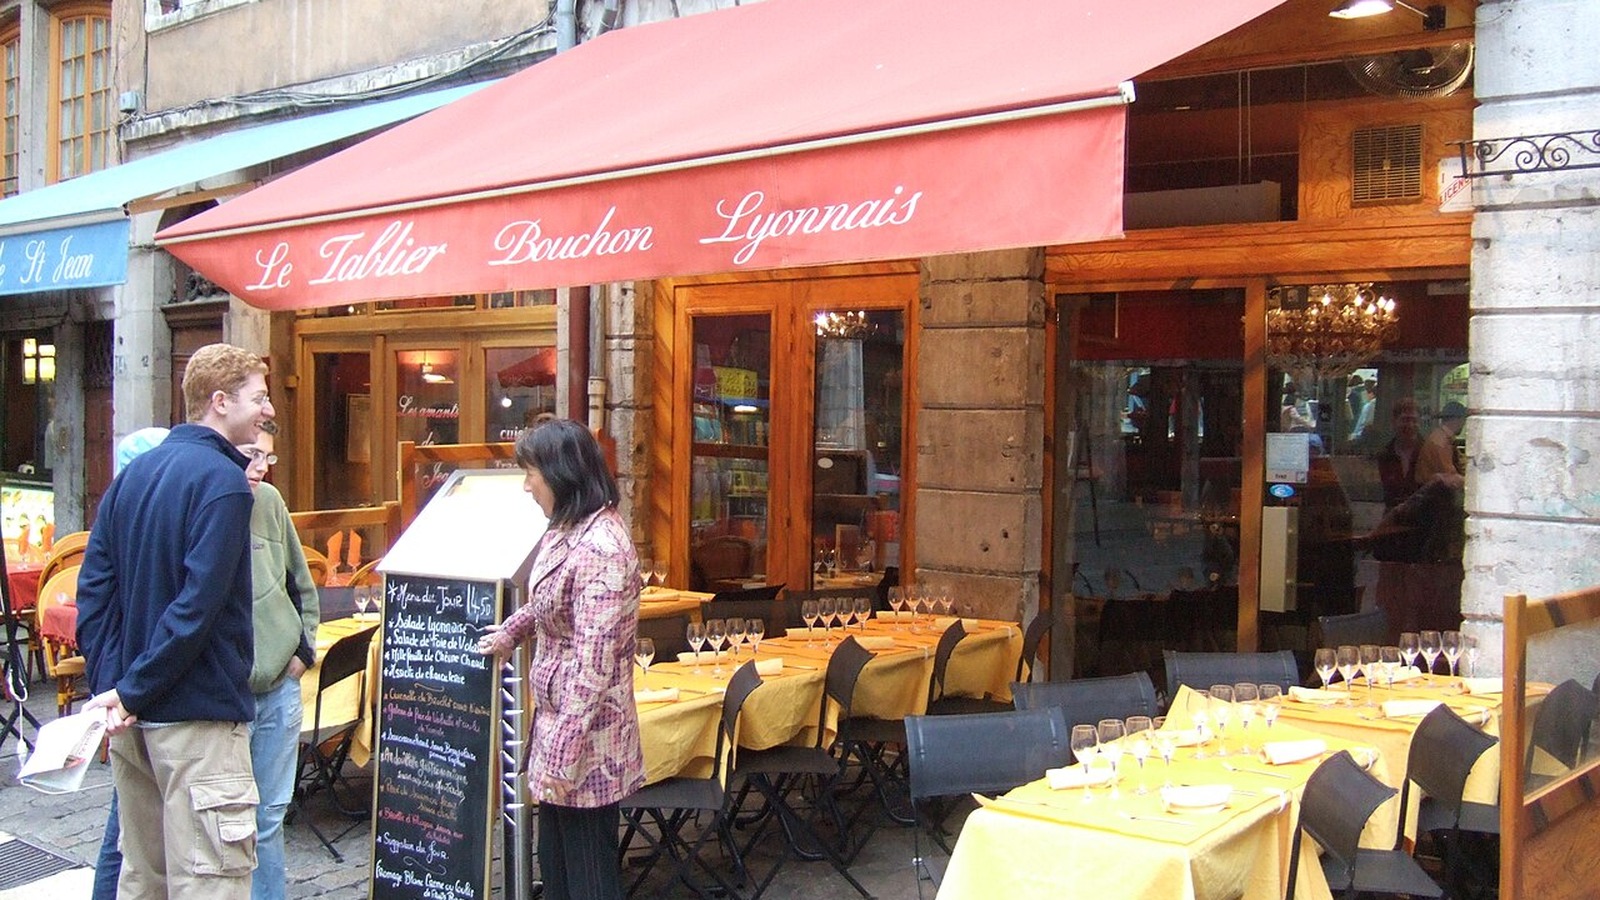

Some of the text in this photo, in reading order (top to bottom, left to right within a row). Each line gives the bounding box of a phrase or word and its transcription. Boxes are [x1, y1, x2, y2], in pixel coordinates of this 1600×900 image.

[246, 185, 922, 290] Le Tablier Bouchon Lyonnais
[20, 240, 45, 284] St
[52, 234, 94, 283] Jean
[399, 395, 417, 417] Les
[394, 612, 426, 631] Salade
[393, 629, 419, 647] Salade
